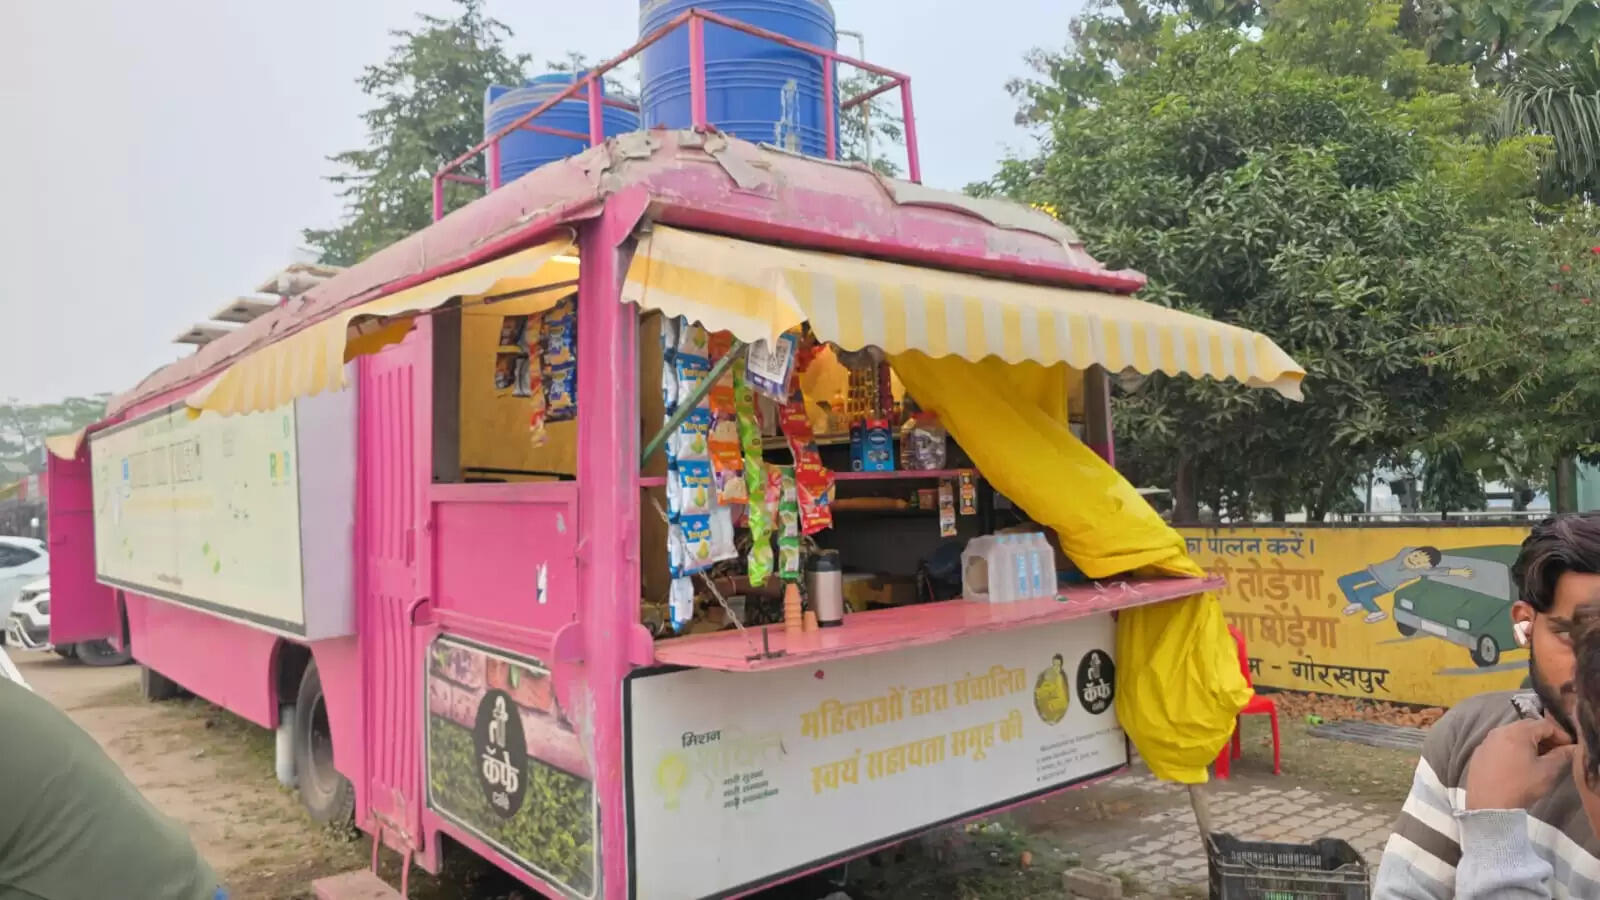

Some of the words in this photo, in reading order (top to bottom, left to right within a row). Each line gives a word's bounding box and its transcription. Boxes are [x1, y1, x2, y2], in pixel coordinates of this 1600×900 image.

[1208, 536, 1262, 557] पालन
[1288, 655, 1390, 693] गोरखपुर
[800, 684, 904, 741] महिलाओं
[953, 663, 1027, 706] संचालित
[681, 729, 721, 749] मिशन
[811, 749, 861, 795] स्वयं
[866, 734, 948, 781] सहायता
[951, 721, 995, 762] समूह
[999, 708, 1024, 742] की
